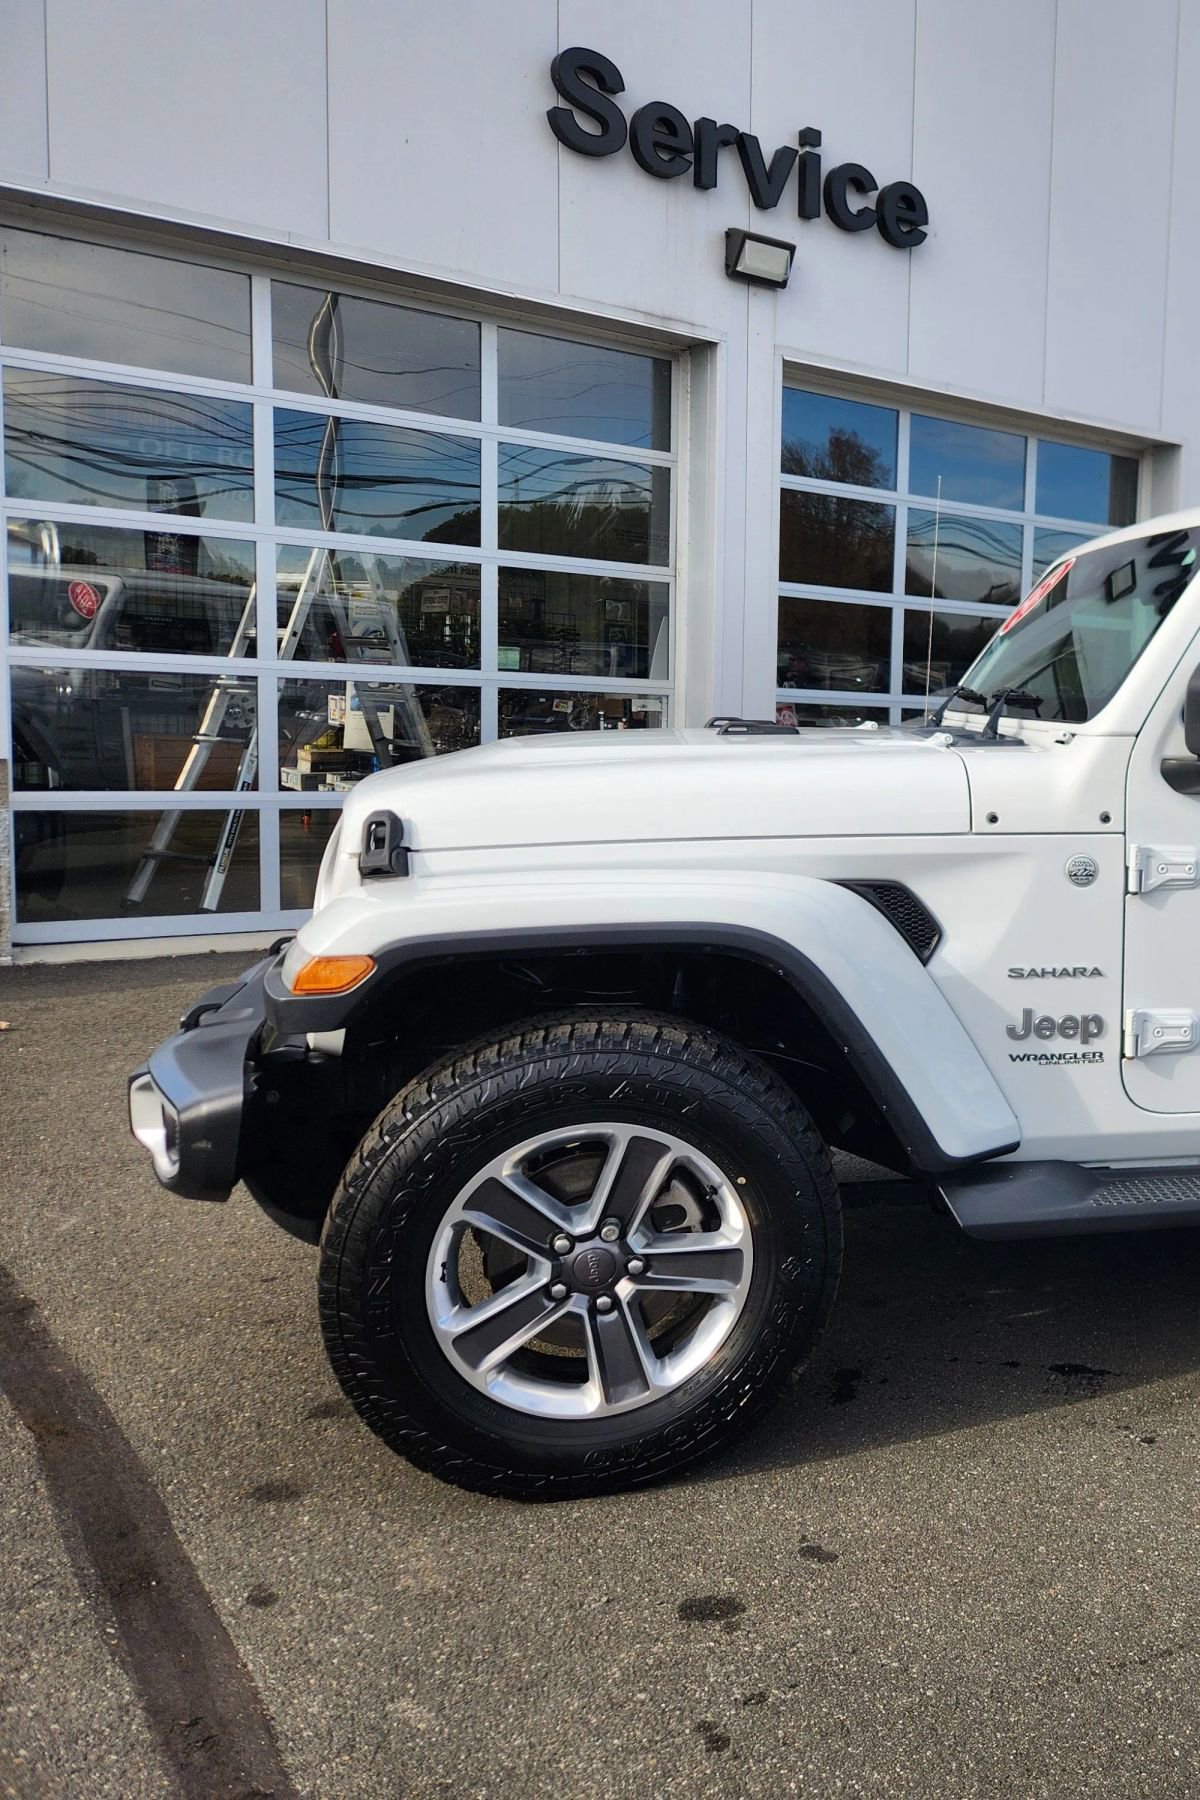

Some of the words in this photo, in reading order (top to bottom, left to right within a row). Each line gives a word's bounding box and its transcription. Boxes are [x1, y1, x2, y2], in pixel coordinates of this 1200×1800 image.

[546, 46, 929, 249] Service
[1007, 966, 1105, 979] SAHARA
[1006, 1007, 1105, 1045] Jeep
[1008, 1051, 1104, 1063] WRANGLER
[1038, 1058, 1105, 1066] UNLIMITED
